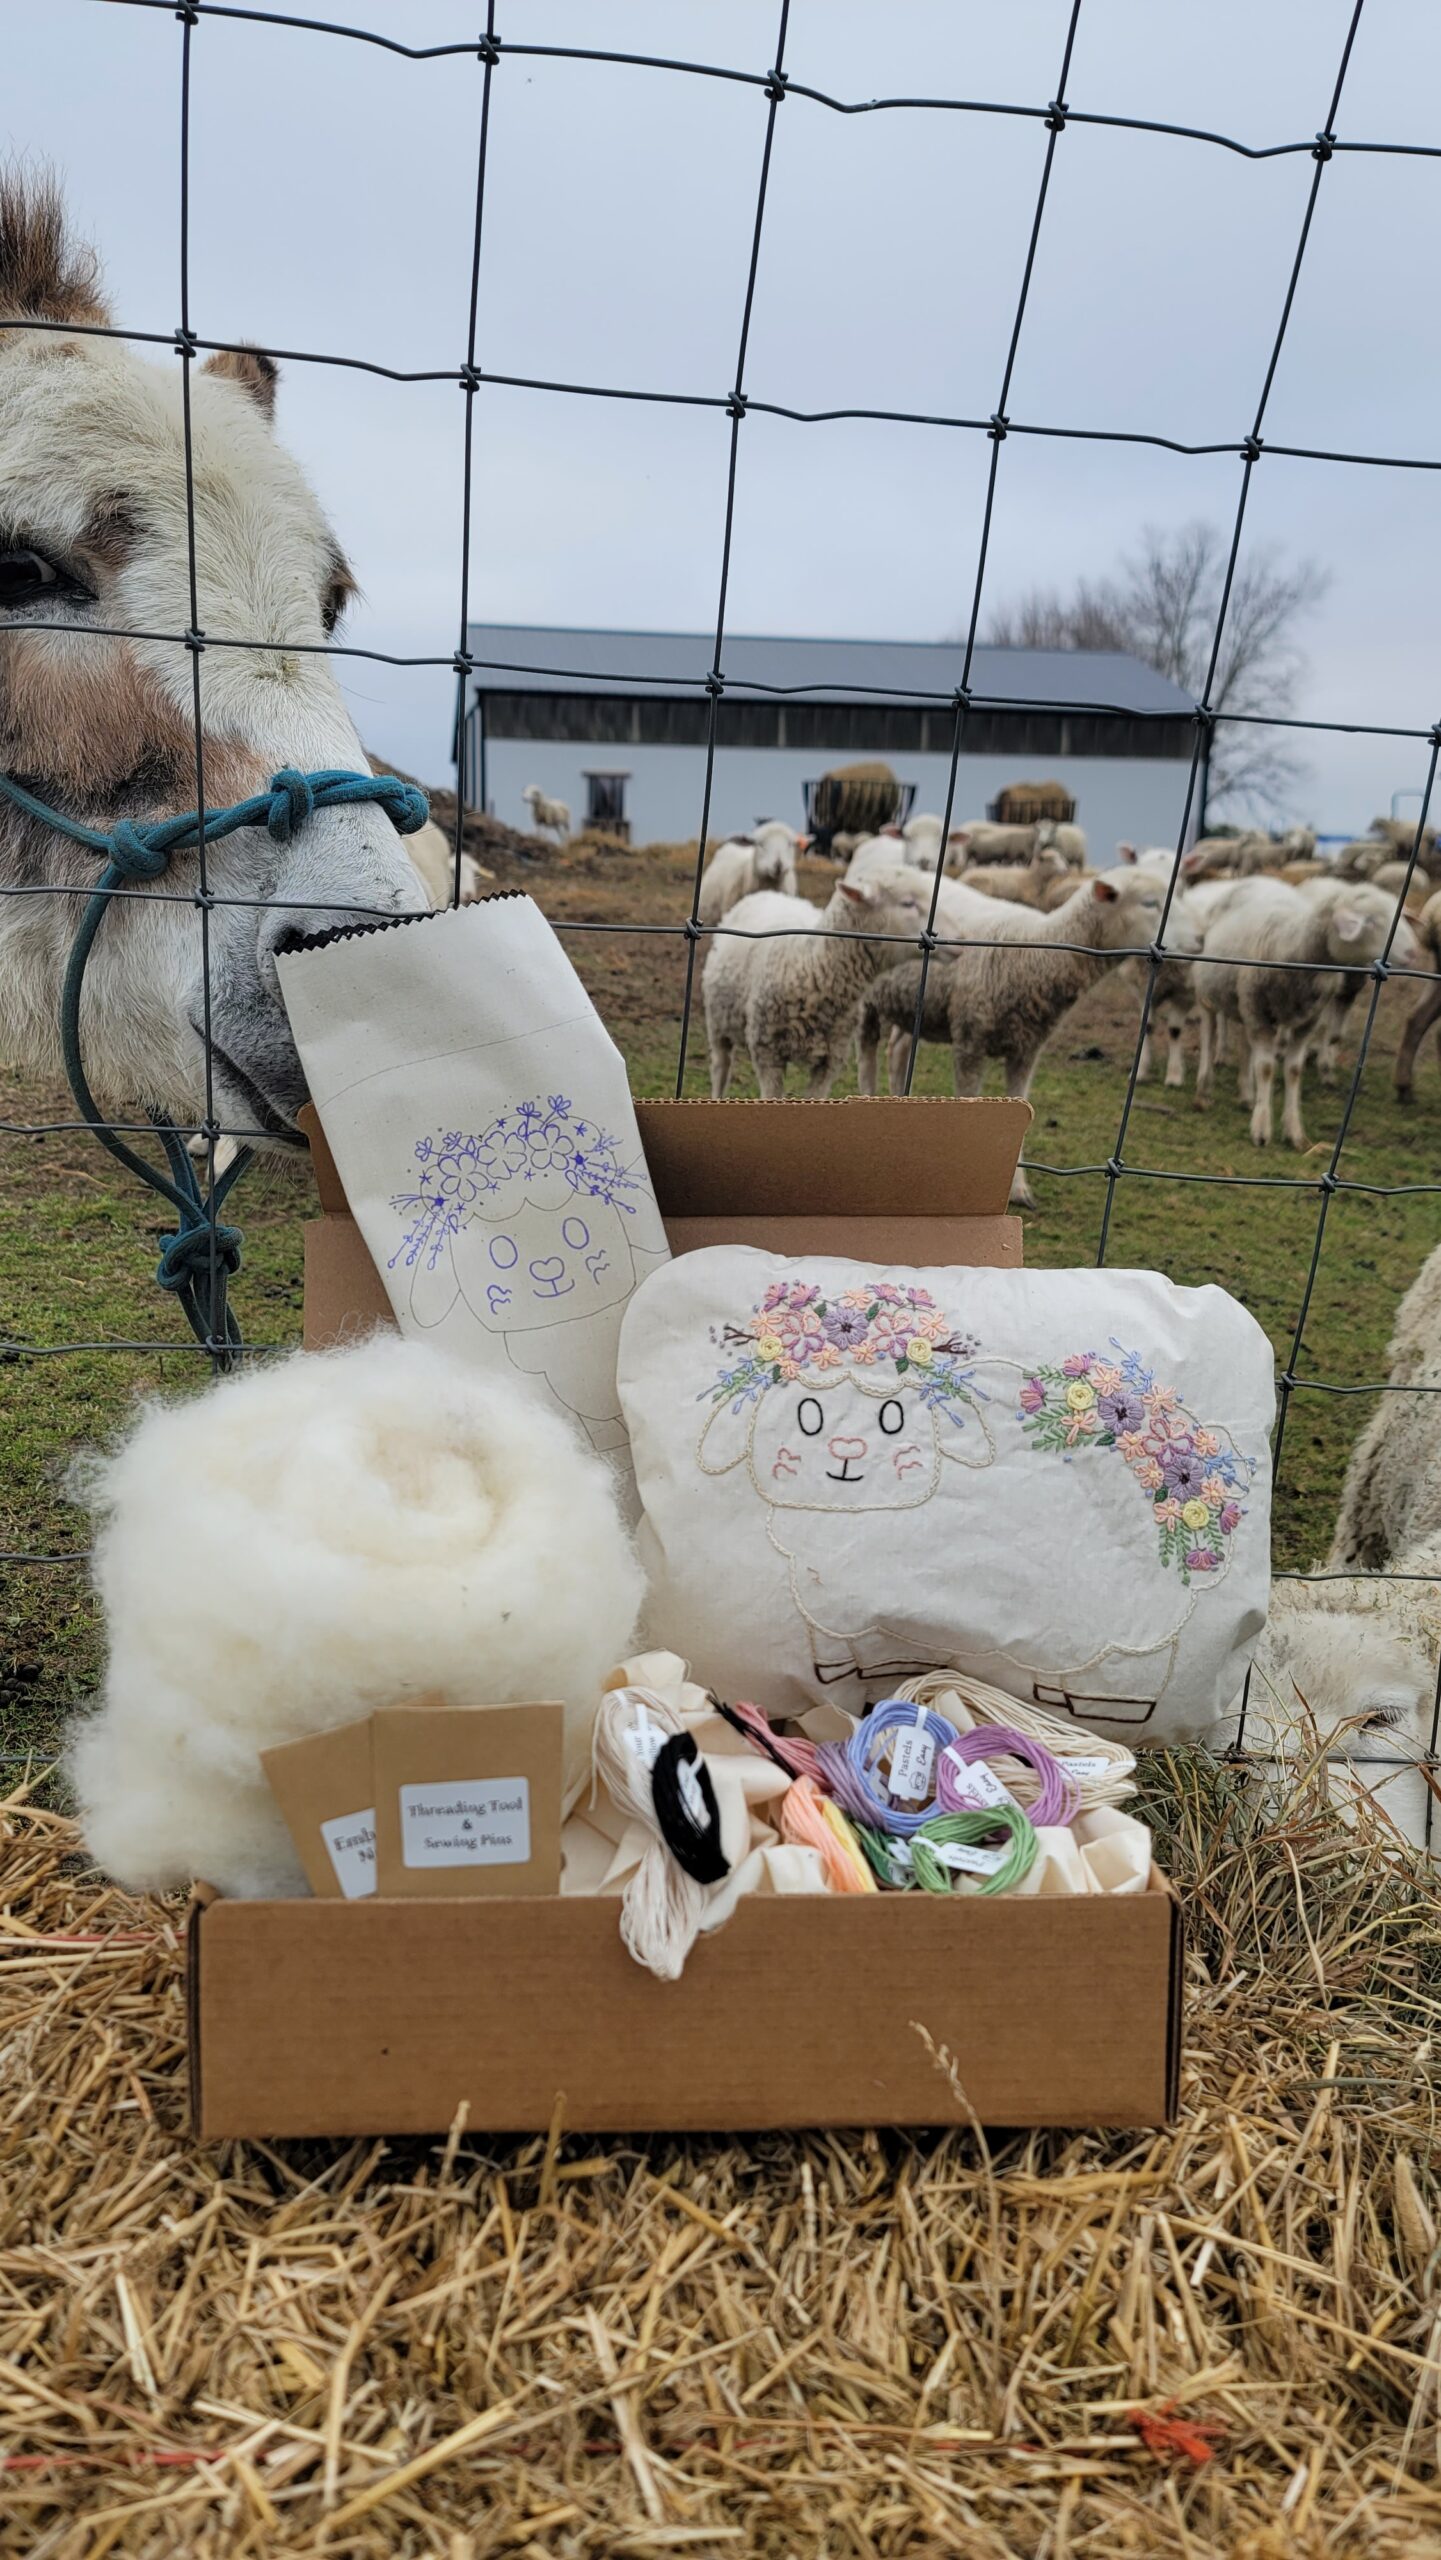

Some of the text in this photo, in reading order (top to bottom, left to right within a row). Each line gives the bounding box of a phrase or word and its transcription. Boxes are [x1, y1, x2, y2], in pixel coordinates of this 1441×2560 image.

[898, 1740, 913, 1777] Pastels
[916, 1744, 931, 1766] Easy
[980, 1772, 997, 1793] Easy
[407, 1797, 523, 1817] Threading Tool
[462, 1818, 472, 1831] &
[424, 1832, 512, 1850] Sewing Pins
